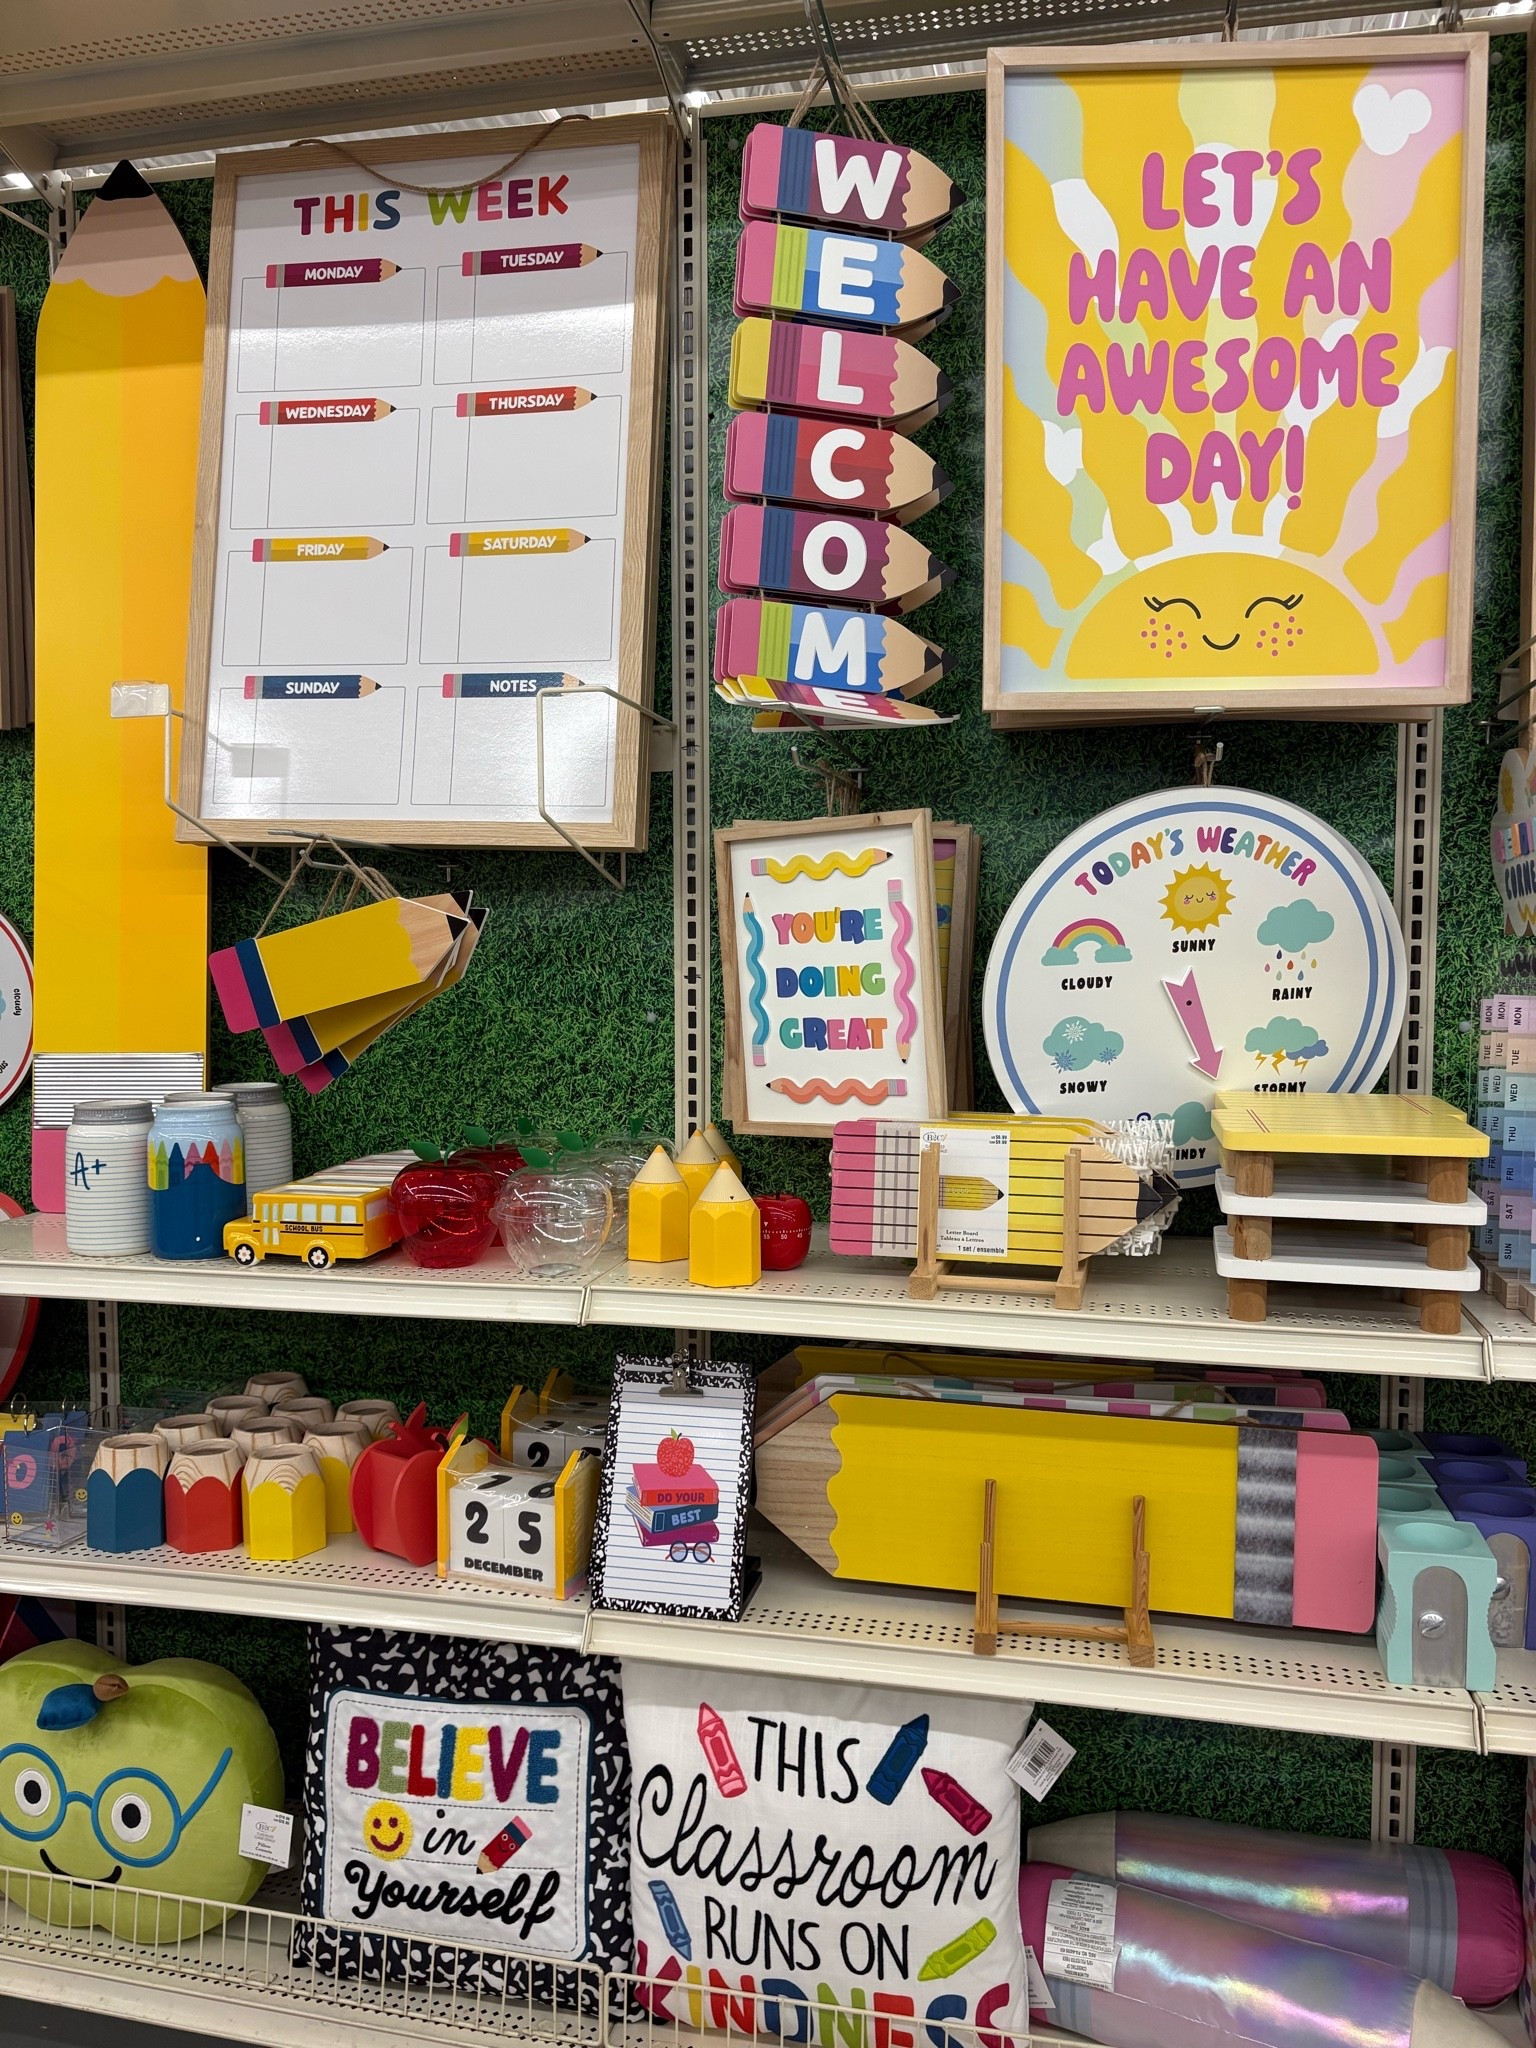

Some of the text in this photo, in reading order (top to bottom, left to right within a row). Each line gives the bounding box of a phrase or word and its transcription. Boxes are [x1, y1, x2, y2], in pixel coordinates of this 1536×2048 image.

[1141, 148, 1322, 230] LET'S
[294, 175, 570, 236] THIS WEEK
[500, 251, 565, 268] TUESDAY
[304, 265, 364, 282] MONDAY
[1068, 237, 1392, 325] HAVE AN
[1056, 333, 1400, 417] AWESOME
[488, 393, 565, 411] THURSDAY
[285, 404, 371, 420] WEDNESDAY
[1145, 424, 1305, 511] DAY!
[297, 543, 345, 557] FRIDAY
[482, 535, 557, 551] SATURDAY
[285, 681, 340, 695] SUNDAY
[489, 679, 537, 693] NOTES
[1074, 825, 1318, 896] TODAY'S WEATHER
[1505, 860, 1536, 900] CORNE
[771, 906, 884, 945] YOU'RE
[1172, 938, 1216, 953] SUNNY
[775, 962, 886, 998] DOING
[1061, 976, 1114, 991] CLOUDY
[13, 988, 22, 1016] cloudy
[1272, 987, 1313, 1001] RAINY
[1485, 1005, 1493, 1023] MON
[1497, 1001, 1506, 1020] MON
[1514, 1007, 1522, 1026] MON
[779, 1017, 888, 1051] GREAT
[1496, 1042, 1504, 1057] TUE
[1511, 1049, 1520, 1066] TUE
[1059, 1079, 1108, 1094] SNOWY
[1493, 1075, 1501, 1093] WED
[1510, 1083, 1518, 1102] WED
[1491, 1116, 1499, 1132] THU
[1508, 1126, 1517, 1143] THU
[1175, 1147, 1208, 1161] INDY
[70, 1152, 107, 1190] A+
[1506, 1167, 1514, 1181] FRI
[1505, 1203, 1514, 1220] SAT
[284, 1224, 309, 1232] SCHOOL
[976, 1246, 1005, 1254] ensemble
[1504, 1242, 1512, 1259] SUN
[657, 1491, 705, 1504] DO YOUR
[671, 1508, 701, 1527] BEST
[465, 1500, 542, 1555] 2 5
[463, 1556, 544, 1582] DECEMBER
[345, 1715, 562, 1804] BELIEVE
[747, 1716, 860, 1804] THIS
[423, 1808, 476, 1855] in
[637, 1763, 998, 1909] Classroom
[704, 1895, 909, 1980] RUNS ON
